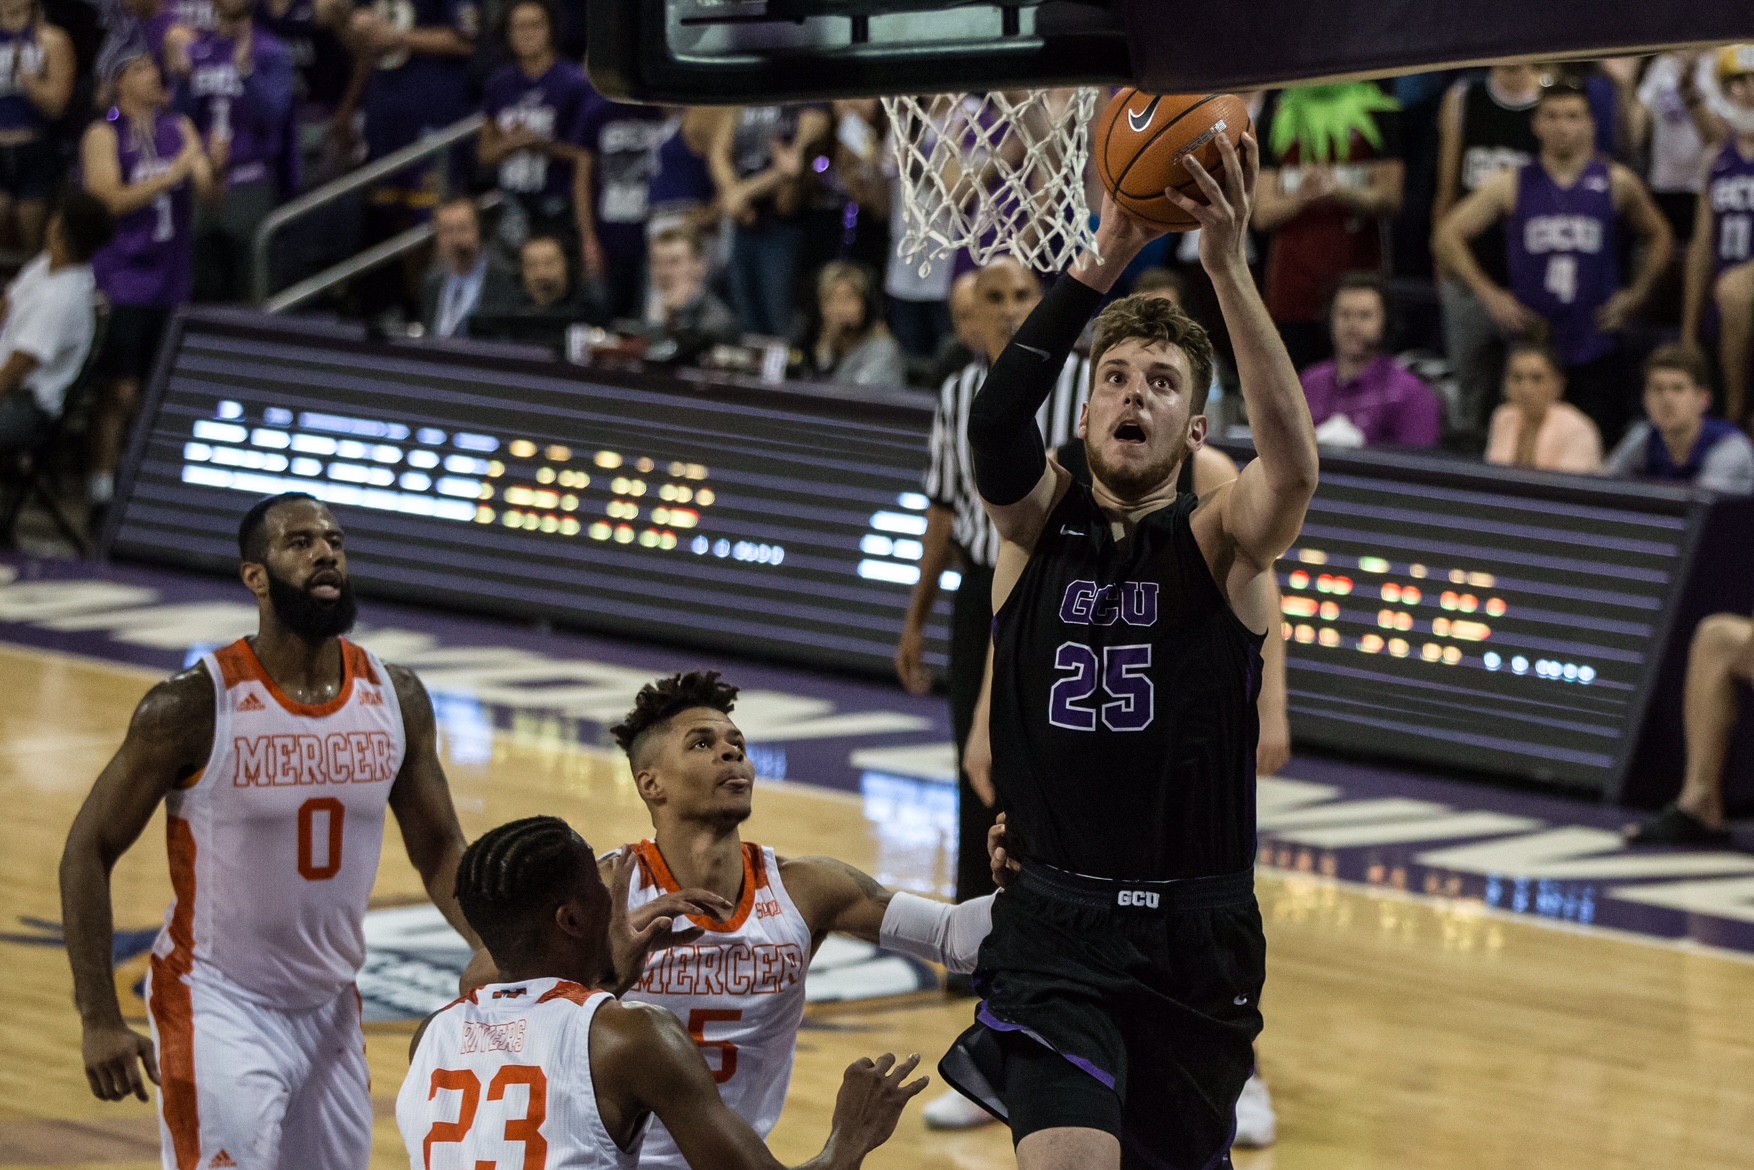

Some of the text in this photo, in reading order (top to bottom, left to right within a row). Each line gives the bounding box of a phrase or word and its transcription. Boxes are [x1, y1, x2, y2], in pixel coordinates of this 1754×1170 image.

[1059, 579, 1159, 627] GCU
[1049, 641, 1154, 732] 25
[233, 731, 392, 787] MERCER
[298, 797, 345, 881] 0
[1117, 890, 1160, 908] GCU
[688, 1009, 743, 1084] 5
[423, 1065, 548, 1170] 23
